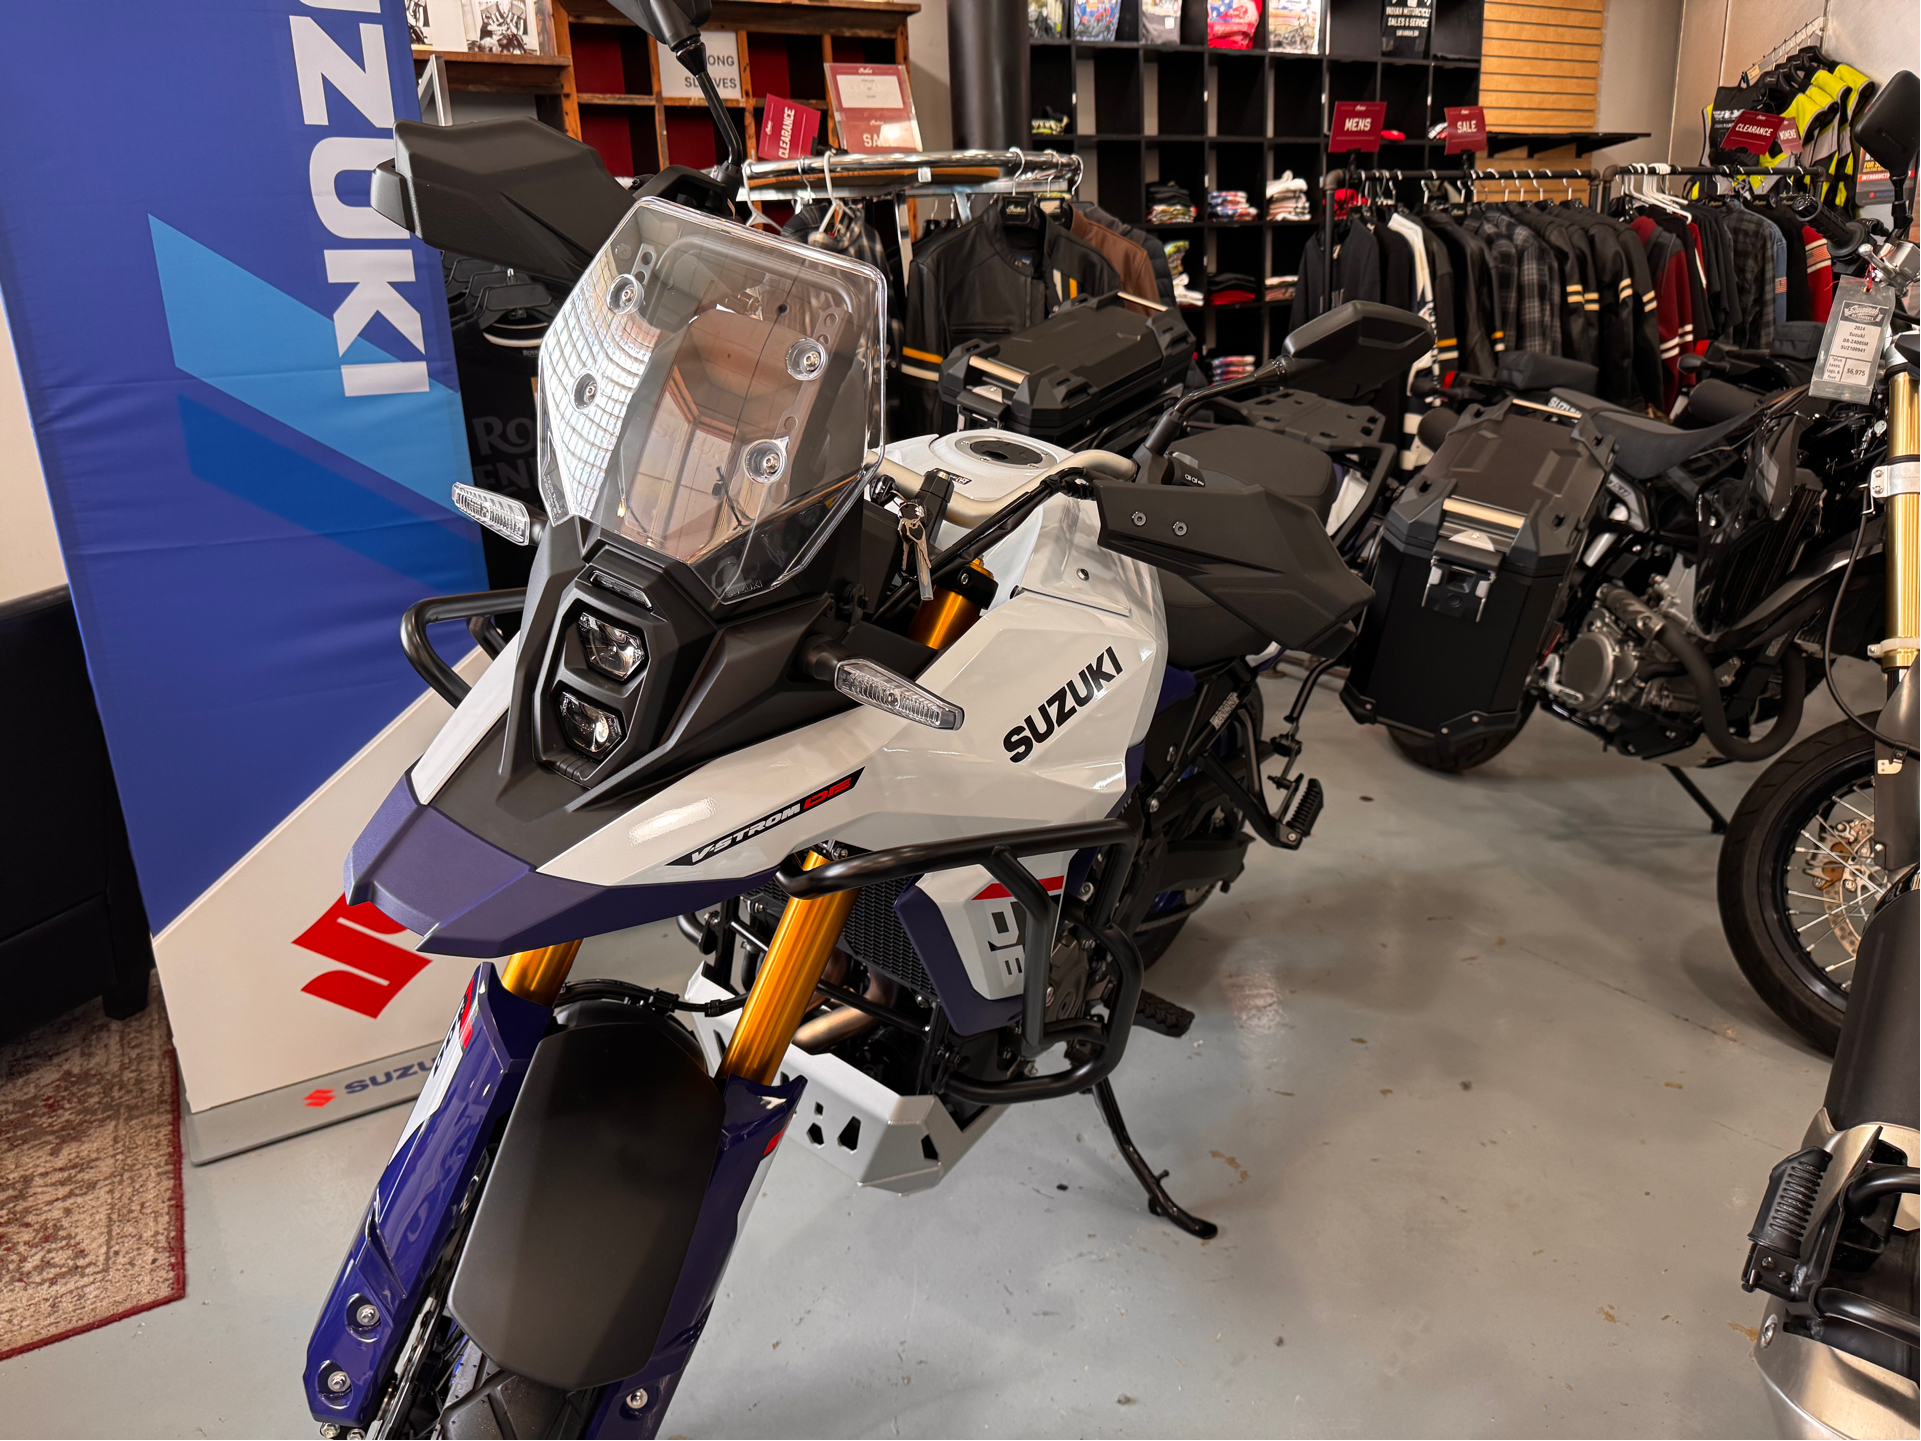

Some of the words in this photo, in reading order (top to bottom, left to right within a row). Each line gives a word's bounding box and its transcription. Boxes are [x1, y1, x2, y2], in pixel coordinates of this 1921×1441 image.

[707, 54, 735, 67] ONG
[684, 76, 737, 89] SLVES
[1344, 118, 1372, 132] MENS
[1457, 120, 1478, 134] SALE
[1735, 123, 1774, 137] CLEARANCE
[778, 106, 796, 159] CLEARANCE
[289, 0, 430, 397] ZUKI
[1849, 331, 1866, 339] Suzuki
[1846, 368, 1866, 377] $6,975
[1003, 645, 1123, 763] SUZUKI
[692, 803, 801, 863] V-STROM
[803, 777, 852, 810] DE
[344, 1057, 438, 1095] SUZU
